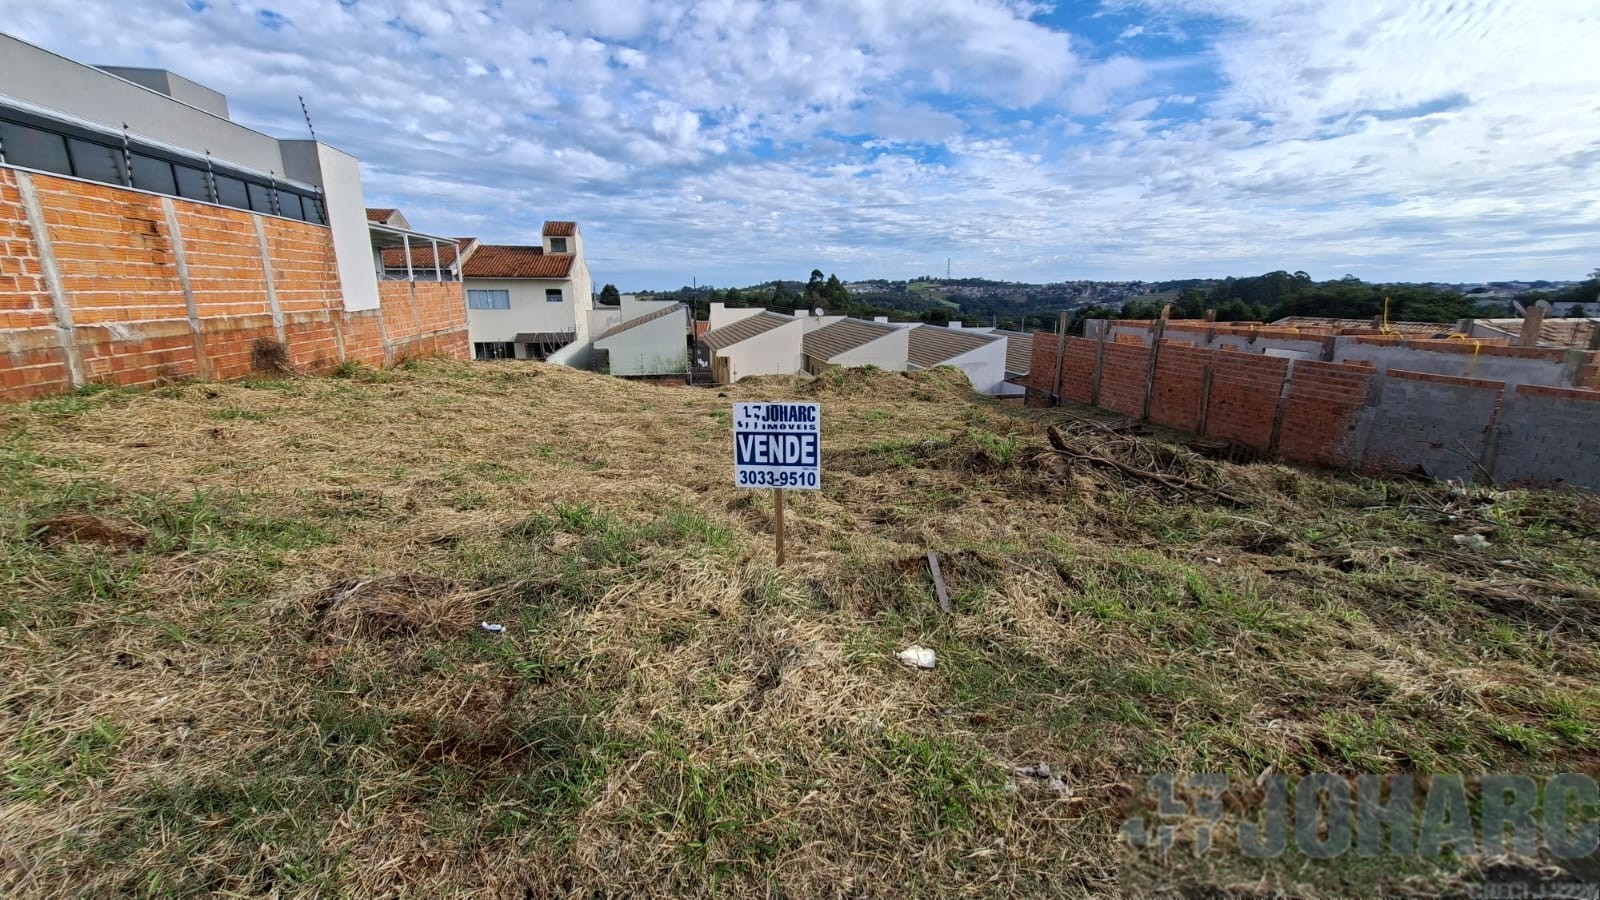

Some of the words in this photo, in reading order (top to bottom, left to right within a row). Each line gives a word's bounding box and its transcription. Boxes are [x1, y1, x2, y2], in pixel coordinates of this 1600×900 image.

[762, 405, 816, 422] JOHARC
[737, 434, 815, 464] VENDE
[739, 470, 816, 486] 3033-9510
